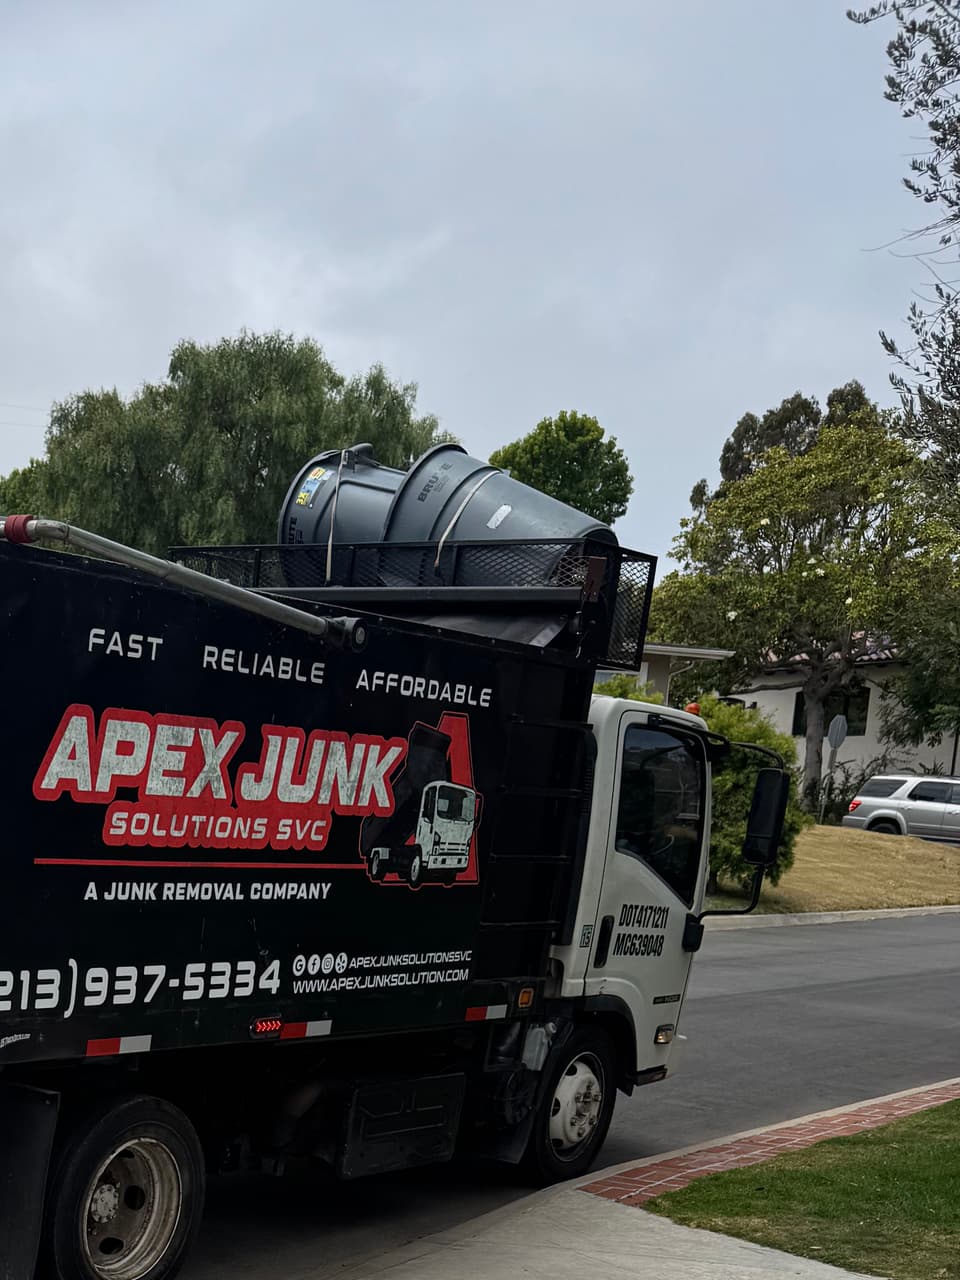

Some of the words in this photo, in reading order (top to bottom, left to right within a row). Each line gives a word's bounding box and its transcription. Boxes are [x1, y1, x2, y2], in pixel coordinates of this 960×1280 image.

[416, 463, 454, 502] BRUE
[88, 628, 163, 661] FAST
[203, 645, 325, 684] RELIABLE
[355, 669, 492, 707] AFFORDABLE
[39, 715, 240, 799] APEX
[240, 734, 403, 808] JUNK
[109, 812, 267, 840] SOLUTIONS
[276, 818, 327, 841] SVC
[84, 882, 98, 900] A
[103, 882, 157, 900] JUNK
[162, 882, 244, 900] REMOVAL
[250, 882, 332, 900] COMPANY
[618, 903, 670, 929] DOT4171211
[348, 950, 473, 969] APEXJUNKSOLUTIONSSVC
[292, 968, 470, 994] WWW.APEXJUNKSOLUTION.COM
